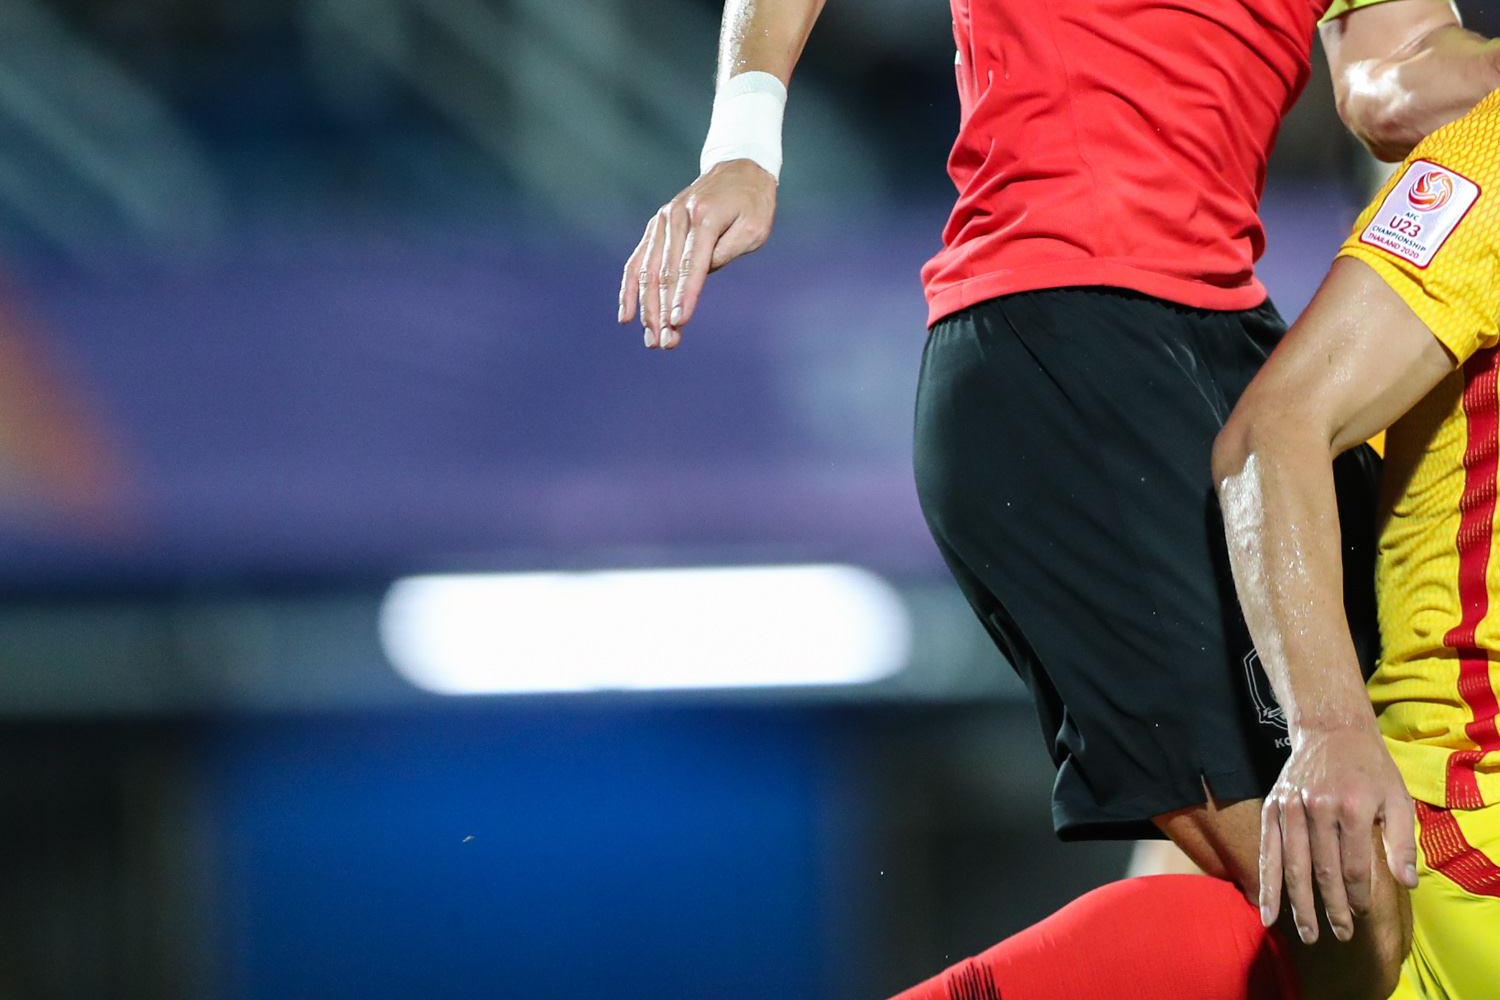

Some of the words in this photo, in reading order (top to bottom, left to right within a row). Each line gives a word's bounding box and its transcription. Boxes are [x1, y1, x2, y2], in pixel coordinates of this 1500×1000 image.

[1389, 216, 1421, 238] U23
[1405, 211, 1419, 221] AFC
[1368, 233, 1400, 249] THAILAND
[1400, 246, 1419, 259] 2020
[1372, 225, 1426, 252] CHAMPIONSHIP
